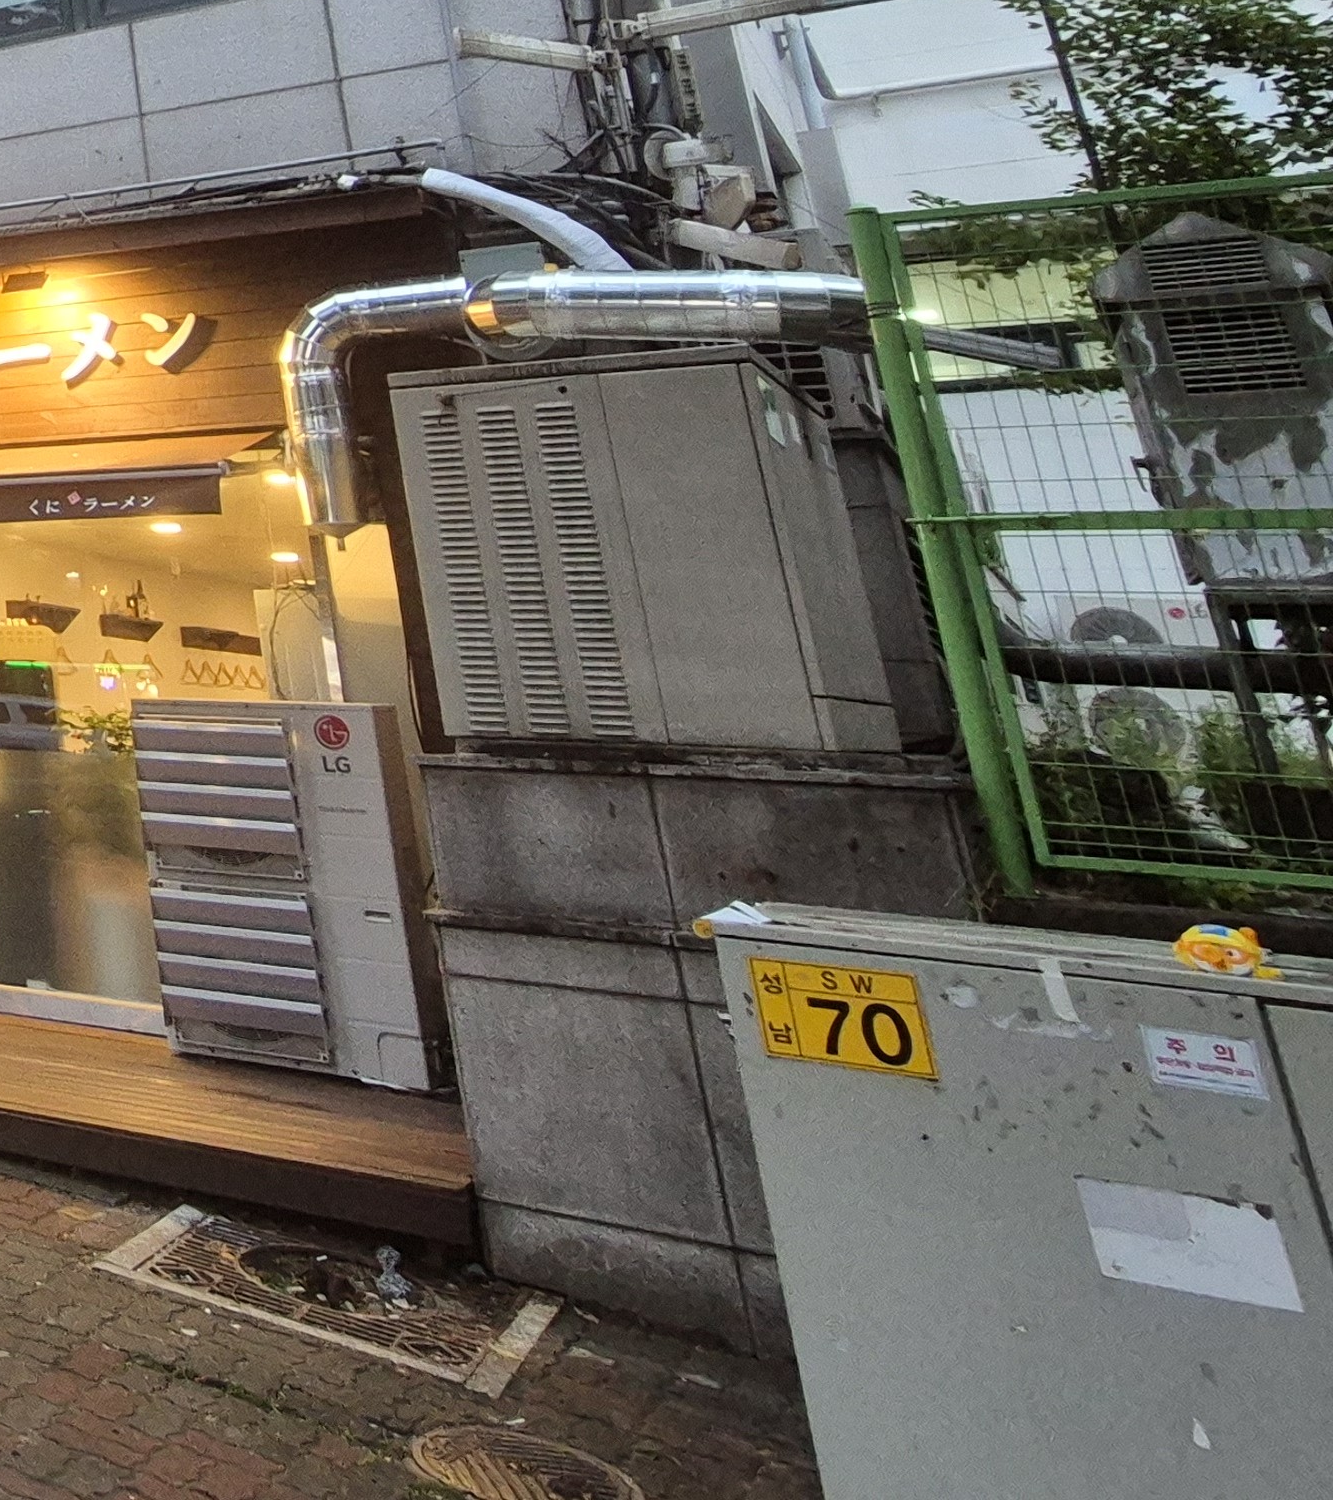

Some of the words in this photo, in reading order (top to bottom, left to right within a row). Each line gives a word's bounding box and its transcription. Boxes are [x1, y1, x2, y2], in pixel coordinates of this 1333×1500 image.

[28, 496, 61, 516] くに
[81, 492, 157, 514] ラーメン
[321, 755, 351, 773] LG
[759, 972, 794, 1046] 성남
[808, 997, 913, 1067] 70
